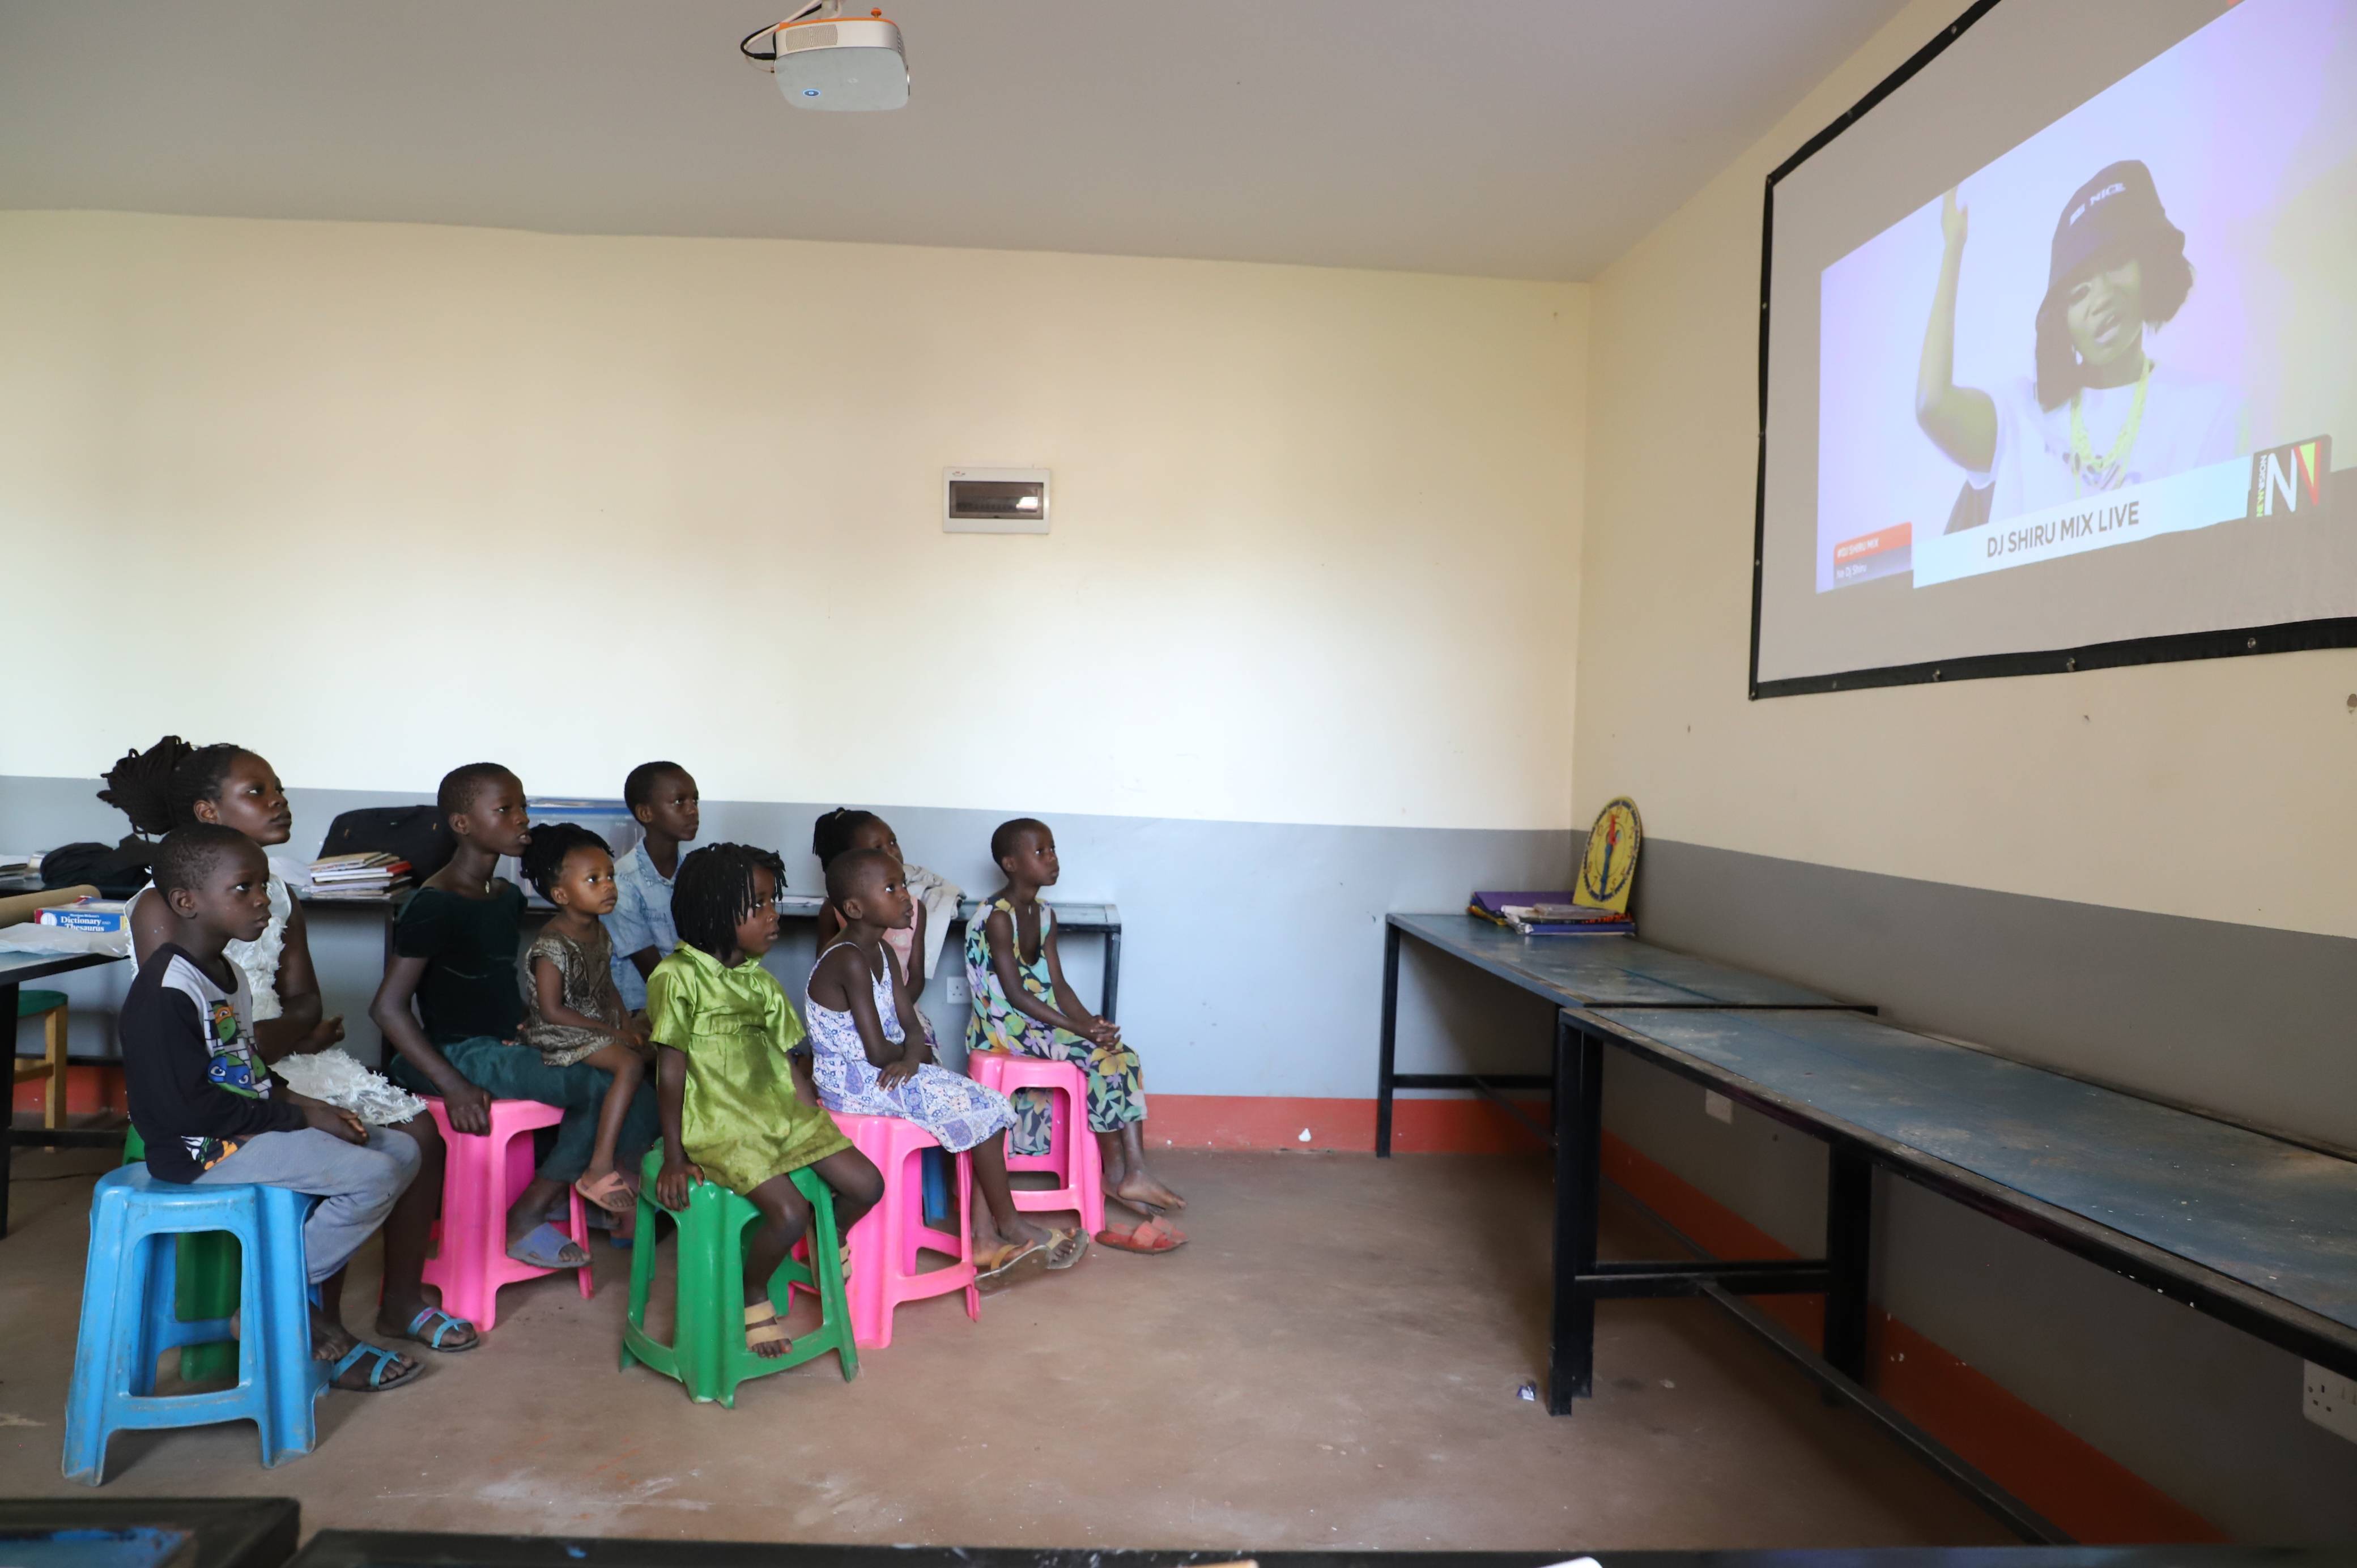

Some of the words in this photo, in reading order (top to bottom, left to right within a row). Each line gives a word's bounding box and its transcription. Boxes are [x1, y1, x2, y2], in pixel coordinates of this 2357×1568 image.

[1987, 534, 2004, 558] DJ
[2007, 521, 2056, 553] SHIRU
[2060, 512, 2094, 542] MIX
[2098, 501, 2139, 532] LIVE
[1867, 538, 1880, 549] MIX
[61, 916, 101, 926] Dictionary
[65, 923, 104, 932] Thesaurus
